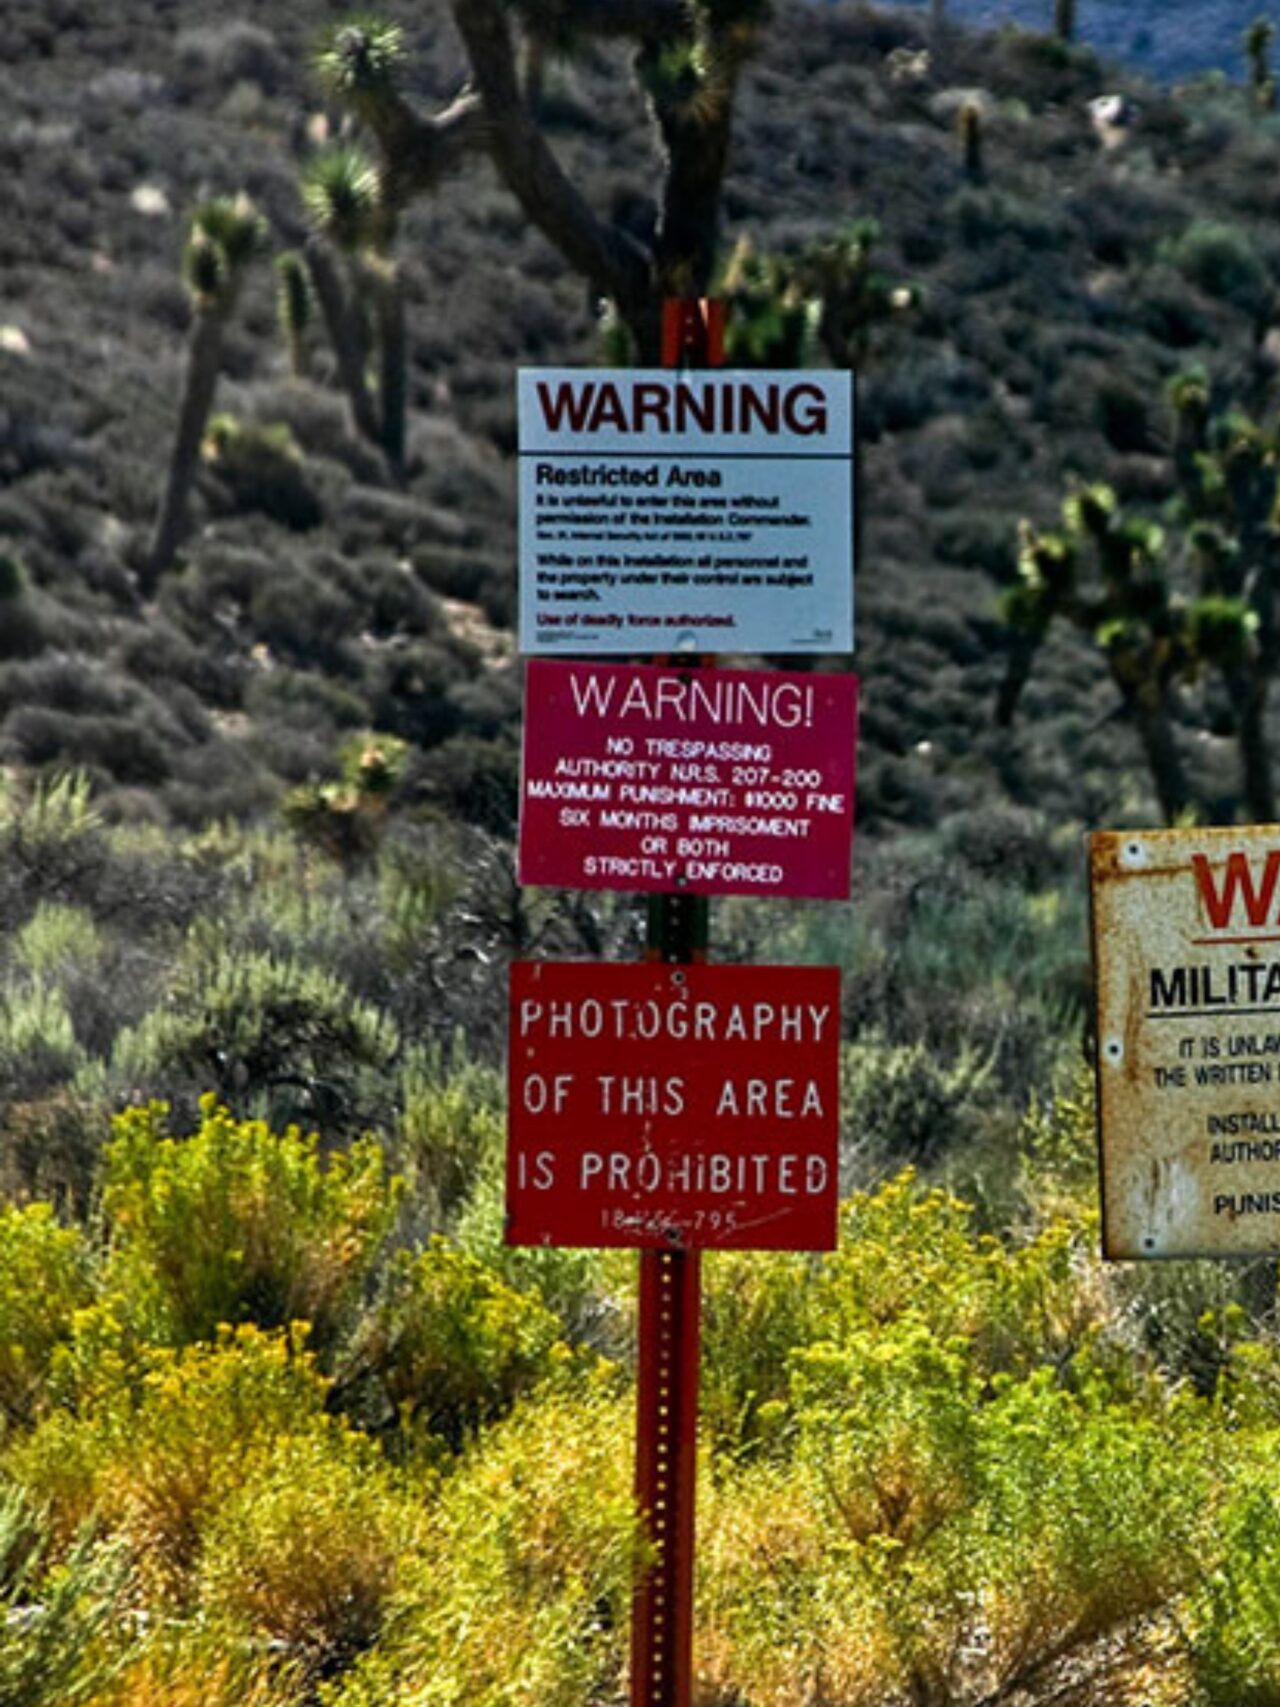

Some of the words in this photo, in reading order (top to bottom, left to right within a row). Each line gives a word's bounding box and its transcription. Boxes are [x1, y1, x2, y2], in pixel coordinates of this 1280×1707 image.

[536, 383, 828, 436] WARNING
[536, 464, 658, 487] Restricted
[666, 466, 722, 488] Area
[562, 494, 618, 507] unlawful
[620, 494, 634, 507] to
[636, 495, 668, 507] enter
[672, 494, 696, 507] this
[699, 496, 727, 508] area
[731, 495, 780, 508] without
[536, 512, 609, 526] permission
[613, 512, 626, 524] of
[630, 512, 650, 524] the
[537, 554, 573, 566] While
[576, 556, 593, 567] on
[596, 554, 621, 566] this
[714, 555, 780, 570] personnel
[782, 555, 809, 568] and
[537, 571, 557, 584] the
[560, 572, 616, 586] property
[620, 572, 658, 585] under
[661, 572, 690, 585] their
[692, 573, 739, 585] control
[742, 575, 762, 585] are
[765, 573, 814, 588] subject
[537, 589, 550, 600] to
[537, 613, 561, 627] Use
[565, 613, 578, 626] of
[581, 613, 624, 628] deadly
[627, 613, 661, 627] force
[664, 613, 737, 628] authorized.
[569, 673, 814, 728] WARNING!
[607, 736, 634, 755] NO
[645, 738, 773, 762] TRESPASSING
[555, 758, 662, 780] AUTHORITY
[732, 766, 822, 788] 207-200
[526, 779, 610, 801] MAXIMUM
[619, 784, 736, 808] PUNISHMENT:
[805, 793, 845, 814] FINE
[558, 806, 590, 827] SIX
[600, 809, 679, 831] MONTHS
[640, 835, 668, 855] OR
[676, 837, 730, 857] BOTH
[583, 856, 677, 879] STRICTLY
[685, 860, 784, 883] ENFORCED
[520, 998, 830, 1041] PHOTOGRAPHY
[1179, 1037, 1195, 1059] IT
[1203, 1036, 1220, 1058] IS
[1153, 1066, 1187, 1087] THE
[1194, 1062, 1272, 1085] WRITTEN
[523, 1073, 575, 1115] OF
[597, 1075, 685, 1116] THIS
[716, 1078, 825, 1118] AREA
[518, 1151, 555, 1190] IS
[580, 1151, 828, 1194] PROHIBITED
